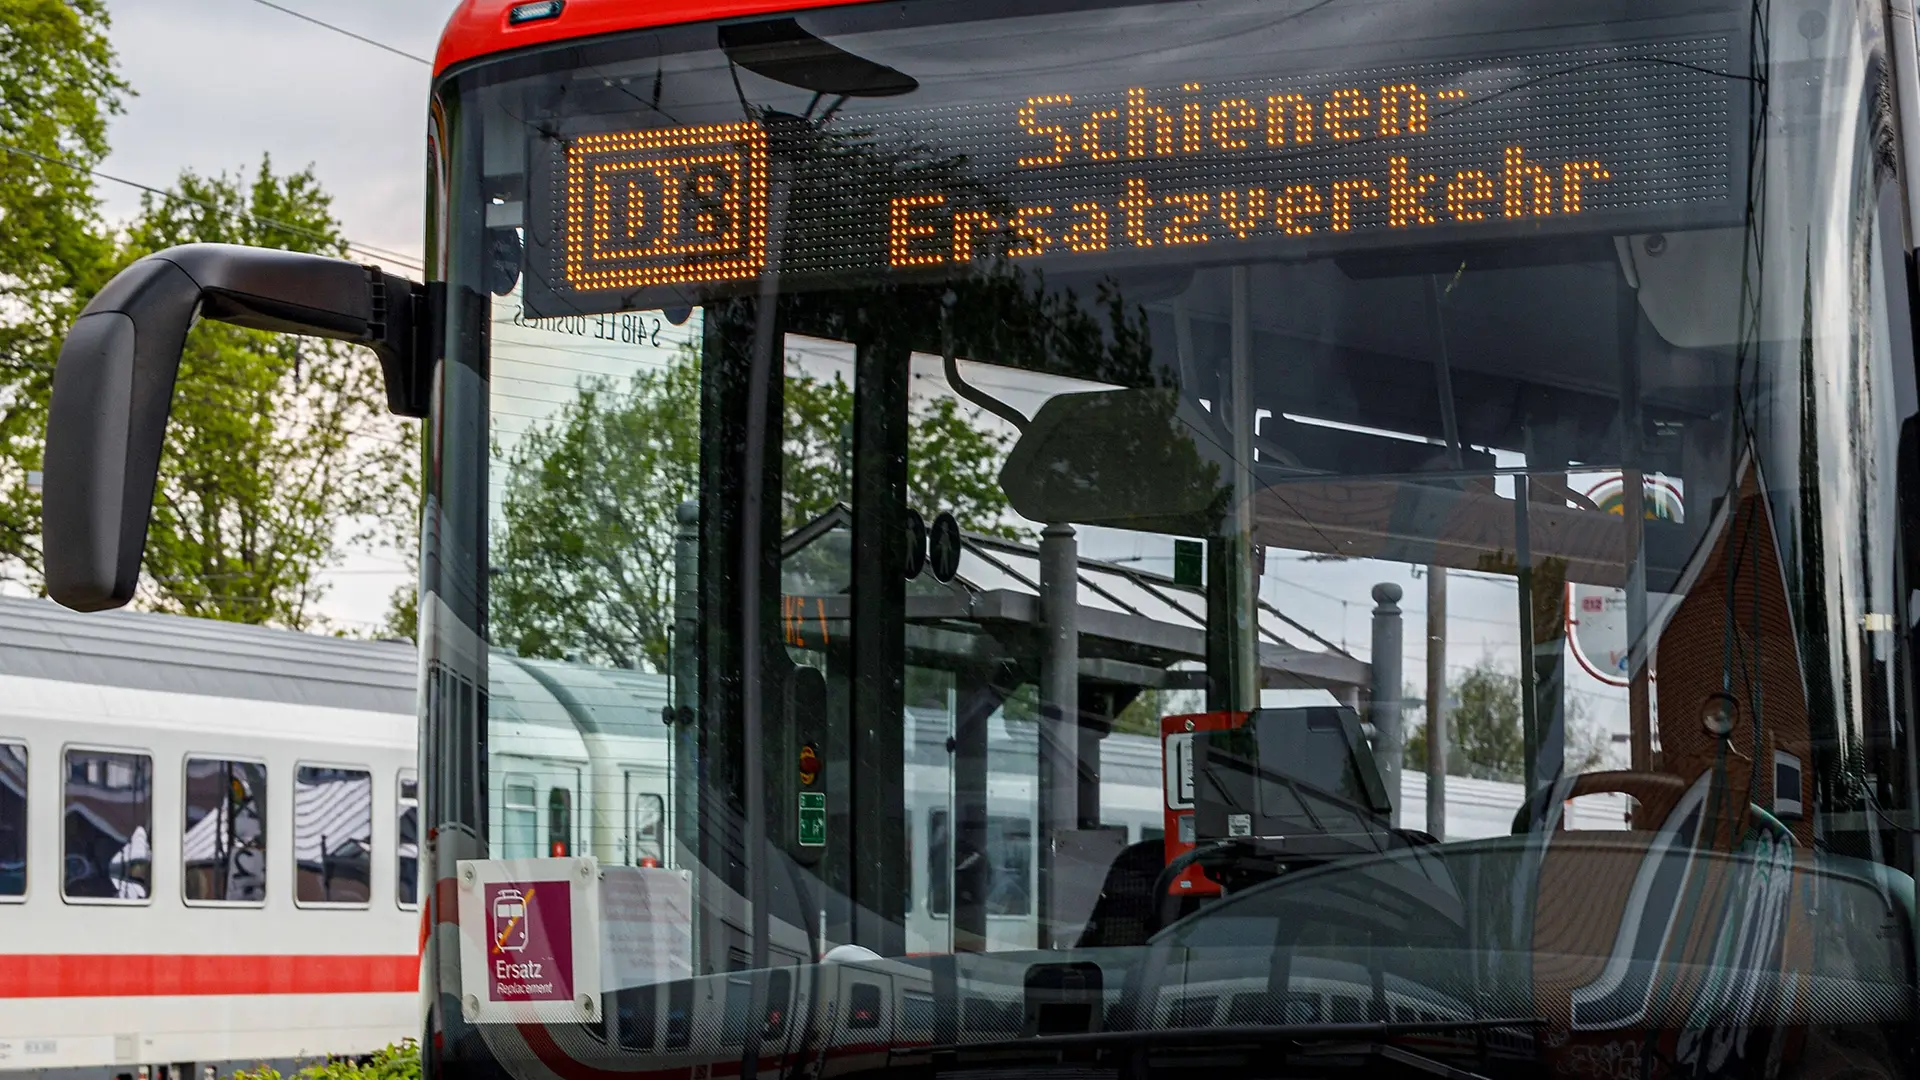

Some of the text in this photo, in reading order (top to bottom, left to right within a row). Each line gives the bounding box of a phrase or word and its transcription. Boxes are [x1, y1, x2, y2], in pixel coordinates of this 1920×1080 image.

[1018, 83, 1464, 165] Schienen-
[590, 149, 744, 263] DB
[891, 147, 1610, 265] Ersatzverkehr
[496, 959, 543, 979] Ersatz
[497, 982, 553, 997] Replacement
